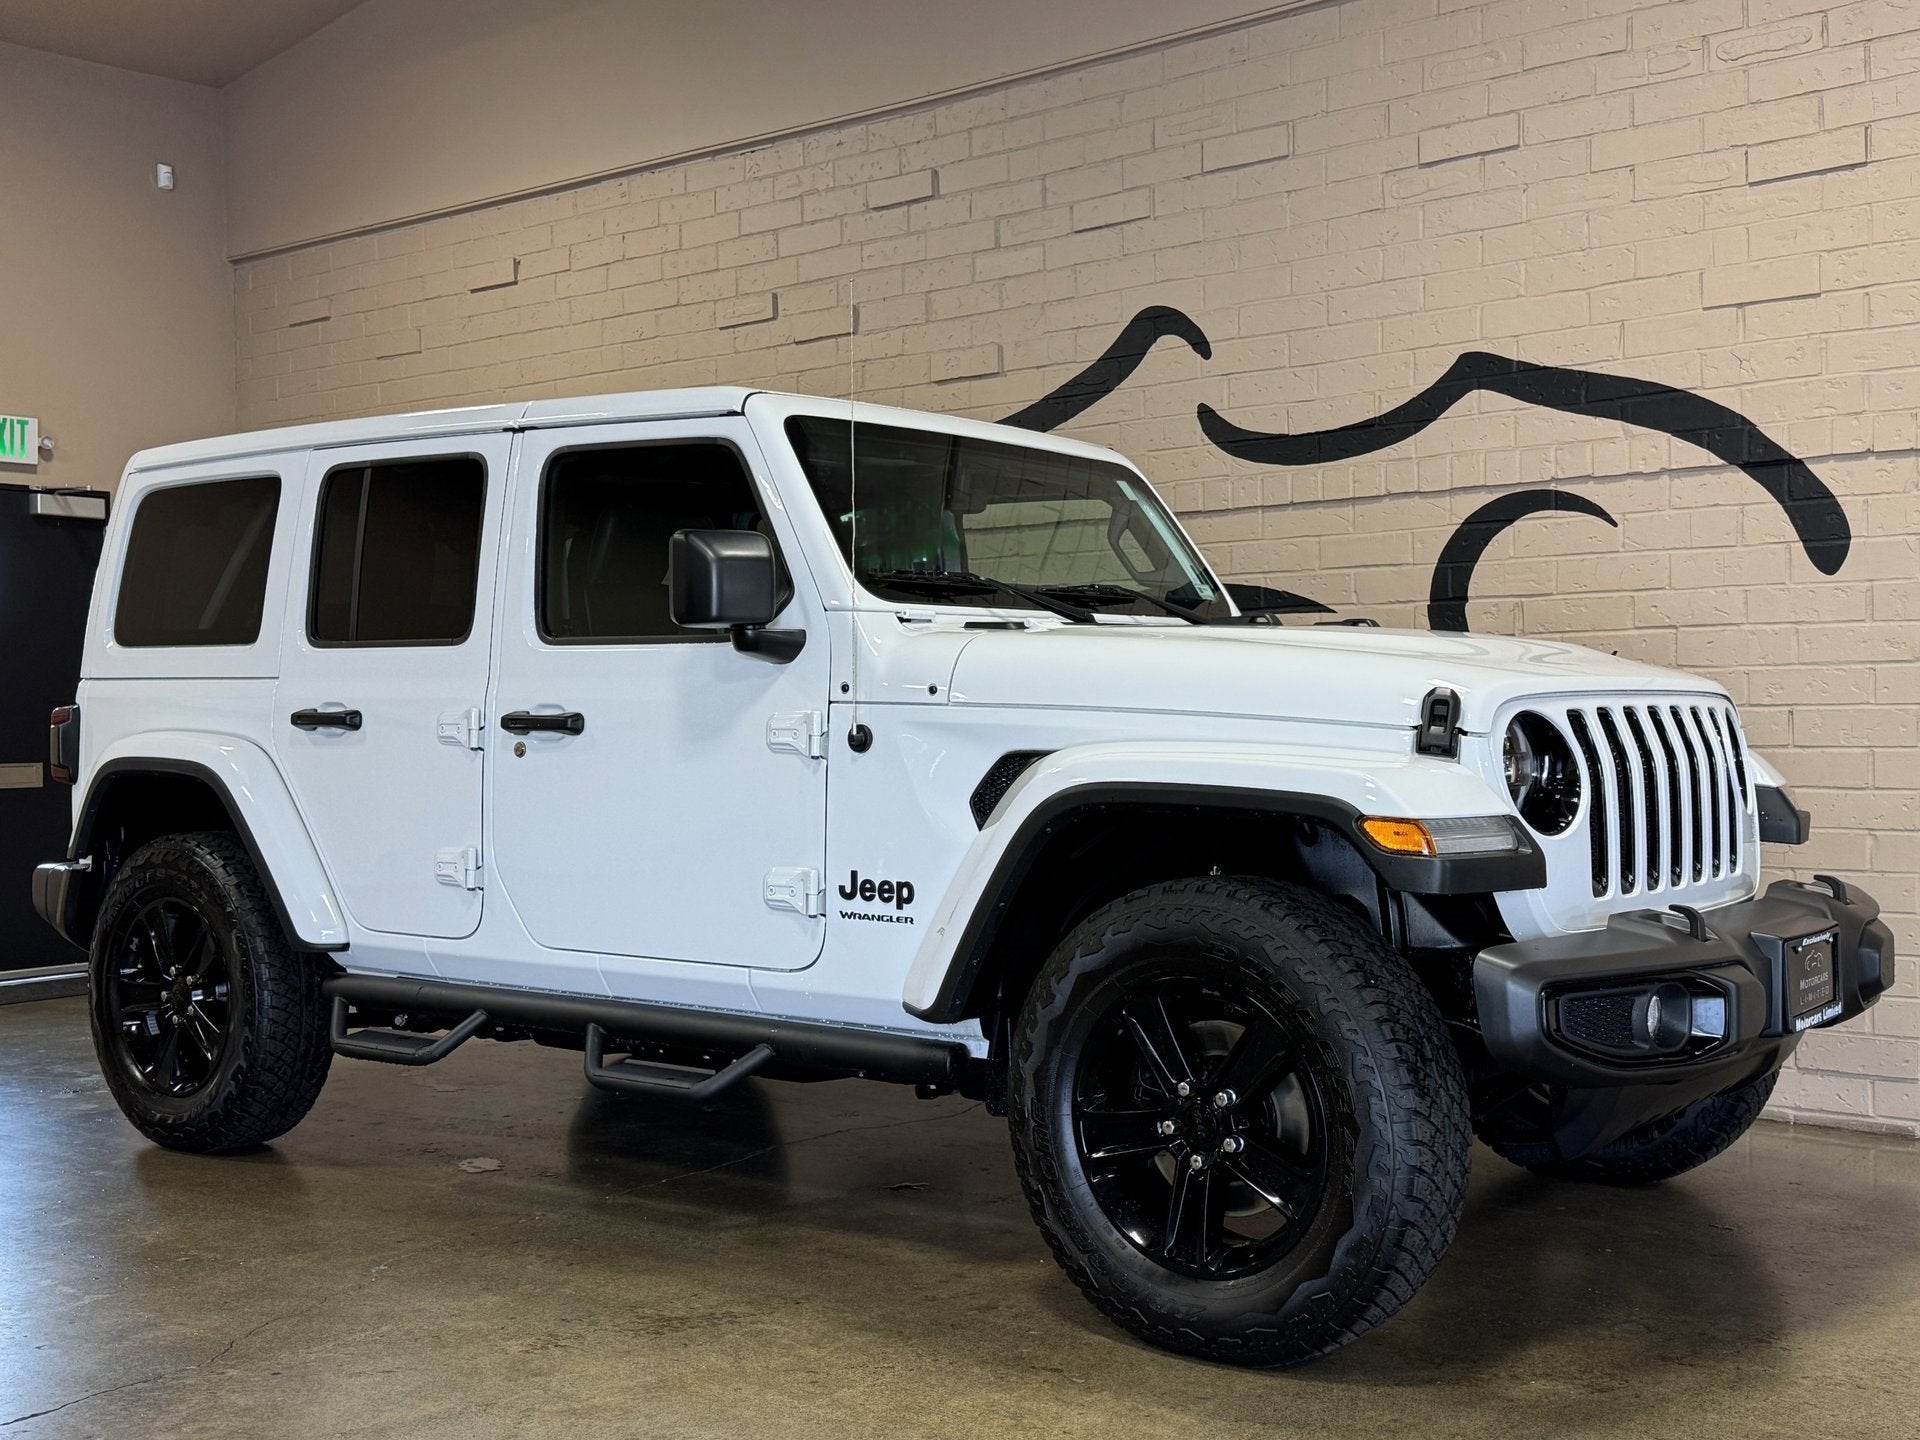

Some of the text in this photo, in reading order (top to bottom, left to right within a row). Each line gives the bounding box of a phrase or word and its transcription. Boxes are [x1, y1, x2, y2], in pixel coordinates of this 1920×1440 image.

[0, 417, 29, 459] XIT
[838, 869, 915, 910] Jeep
[839, 910, 915, 925] WRANGLER
[1802, 931, 1831, 946] Exclusively
[1795, 1001, 1842, 1032] Motorcars Limited
